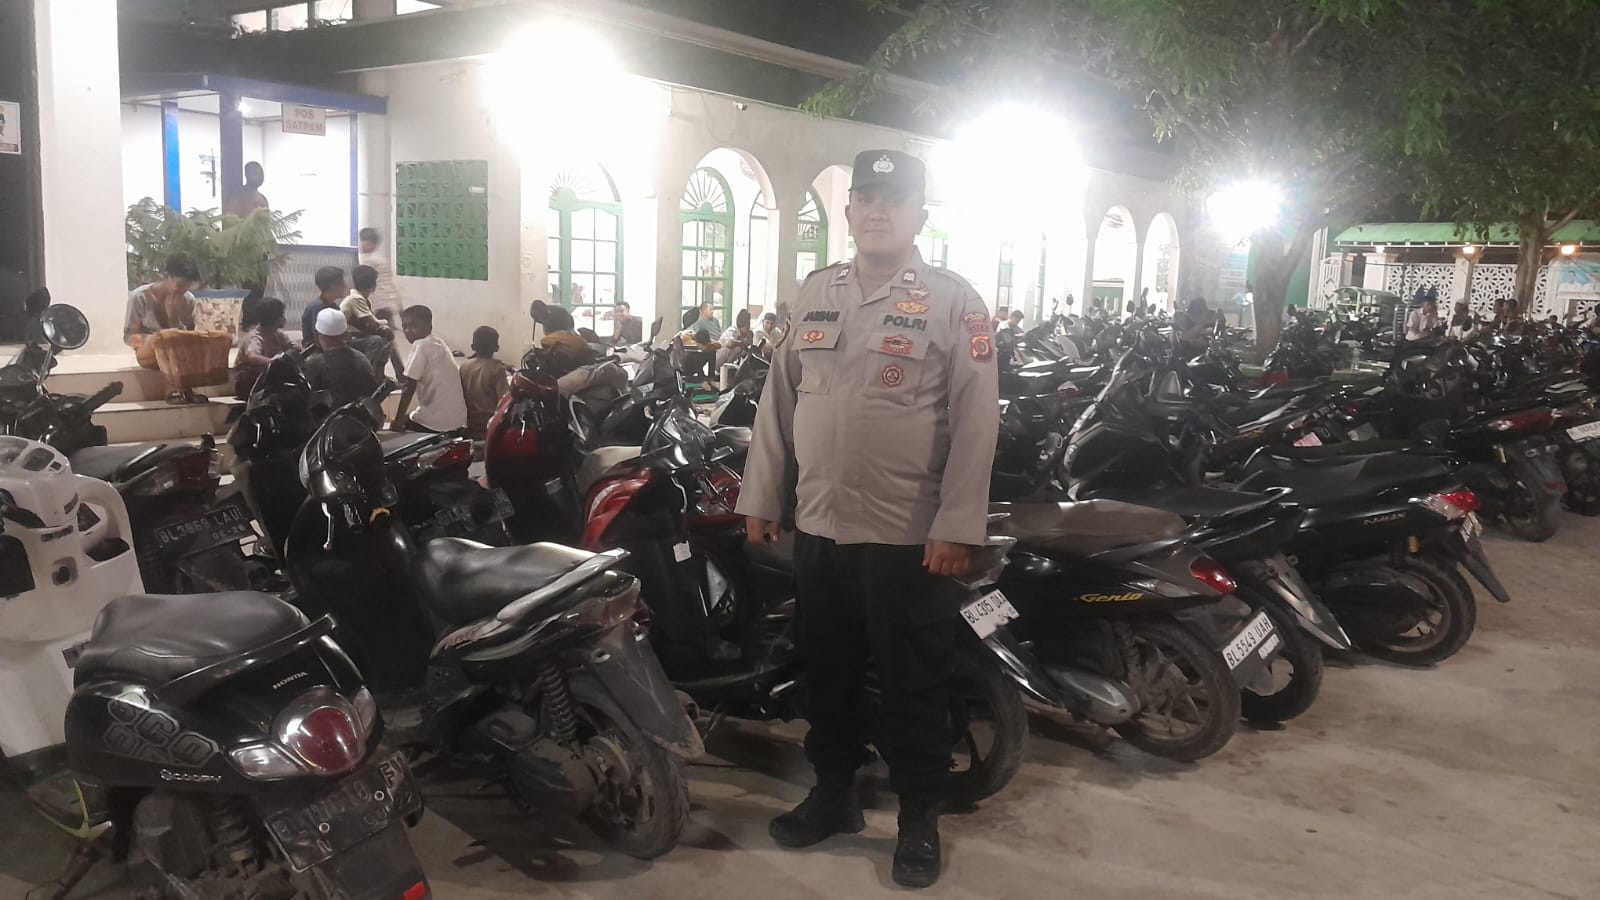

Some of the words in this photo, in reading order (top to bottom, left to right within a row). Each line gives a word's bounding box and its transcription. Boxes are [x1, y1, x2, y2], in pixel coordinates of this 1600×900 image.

[295, 109, 314, 119] POS
[883, 314, 928, 331] POLRI
[963, 609, 980, 624] BL
[1226, 649, 1240, 667] BL
[1236, 631, 1257, 657] 5549
[1254, 616, 1272, 638] UAH
[272, 671, 309, 690] HONDA
